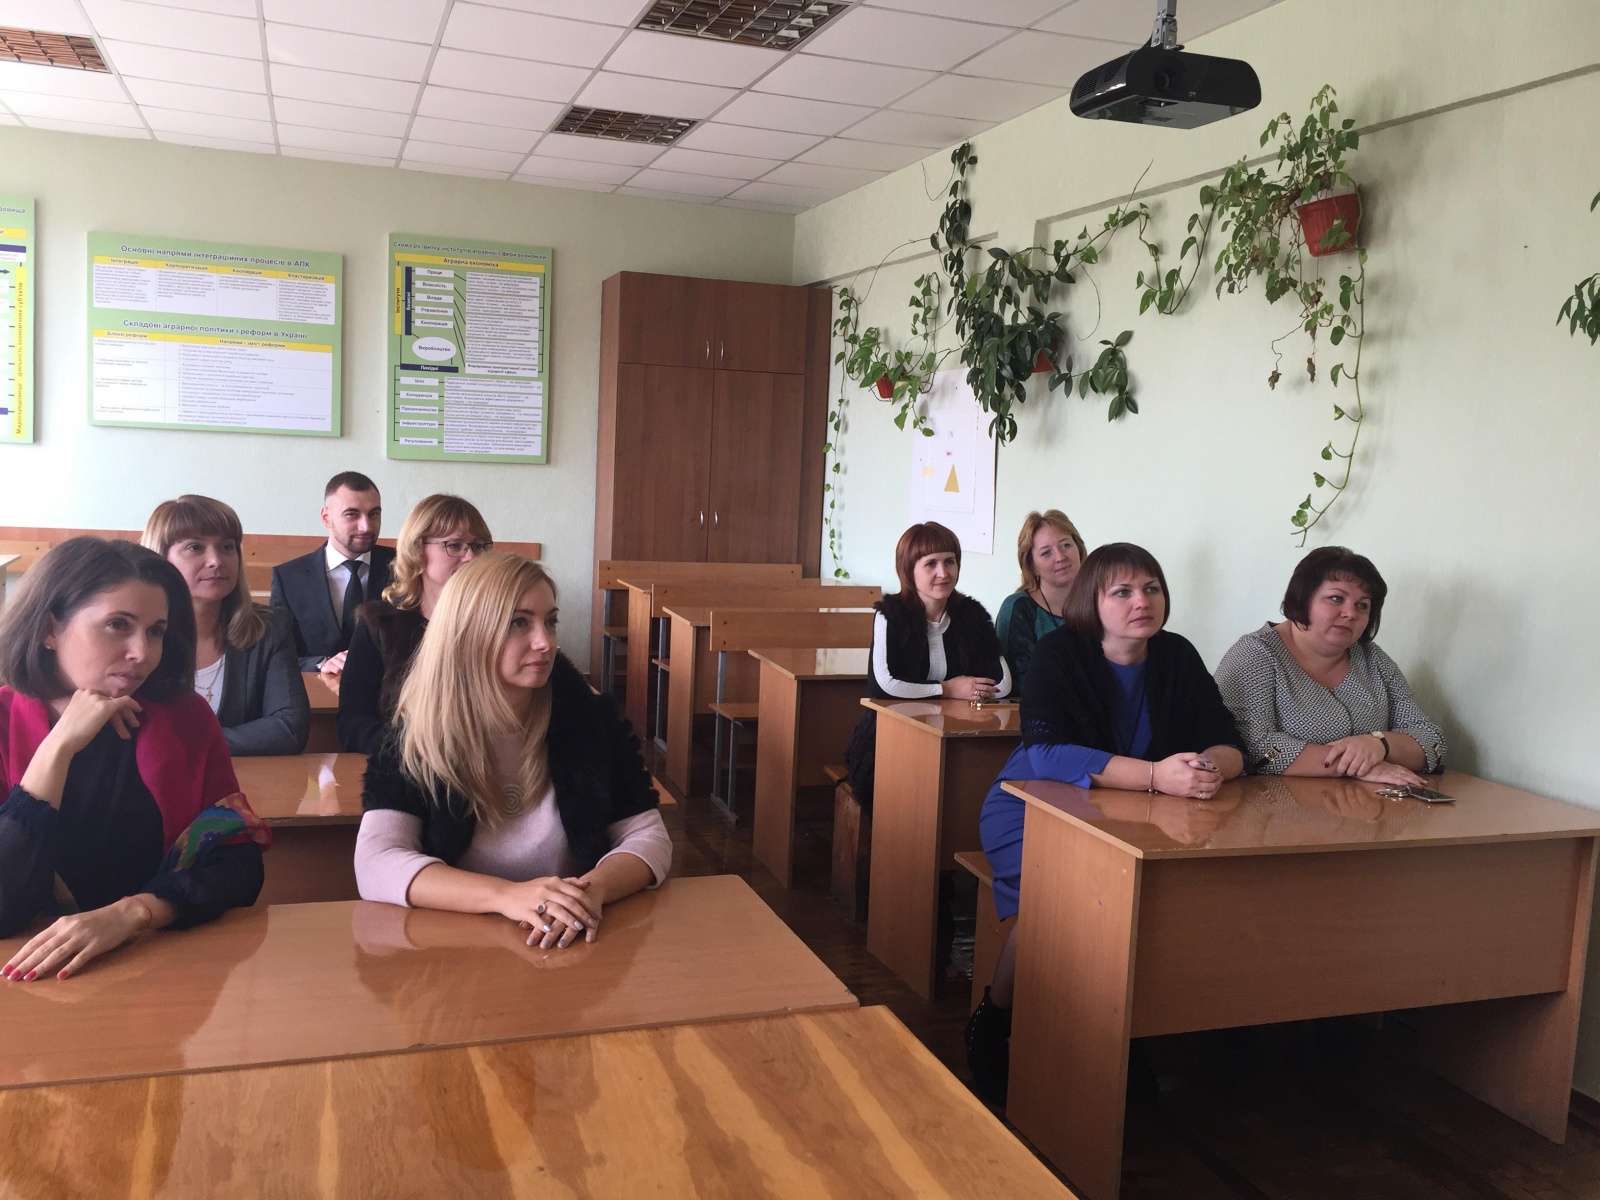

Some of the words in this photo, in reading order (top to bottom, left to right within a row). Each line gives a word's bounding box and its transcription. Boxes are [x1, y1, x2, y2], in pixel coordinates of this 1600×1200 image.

[121, 245, 155, 254] Основні
[156, 248, 192, 258] напрями
[194, 252, 248, 262] інтеграційних
[250, 256, 285, 266] процесів
[294, 260, 310, 268] АПК
[443, 257, 468, 265] Аграрна
[123, 319, 161, 329] Складові
[163, 323, 198, 332] аграрної
[199, 325, 234, 334] політики
[240, 329, 272, 338] реформ
[280, 331, 308, 339] Україні
[418, 344, 451, 352] Виробництво
